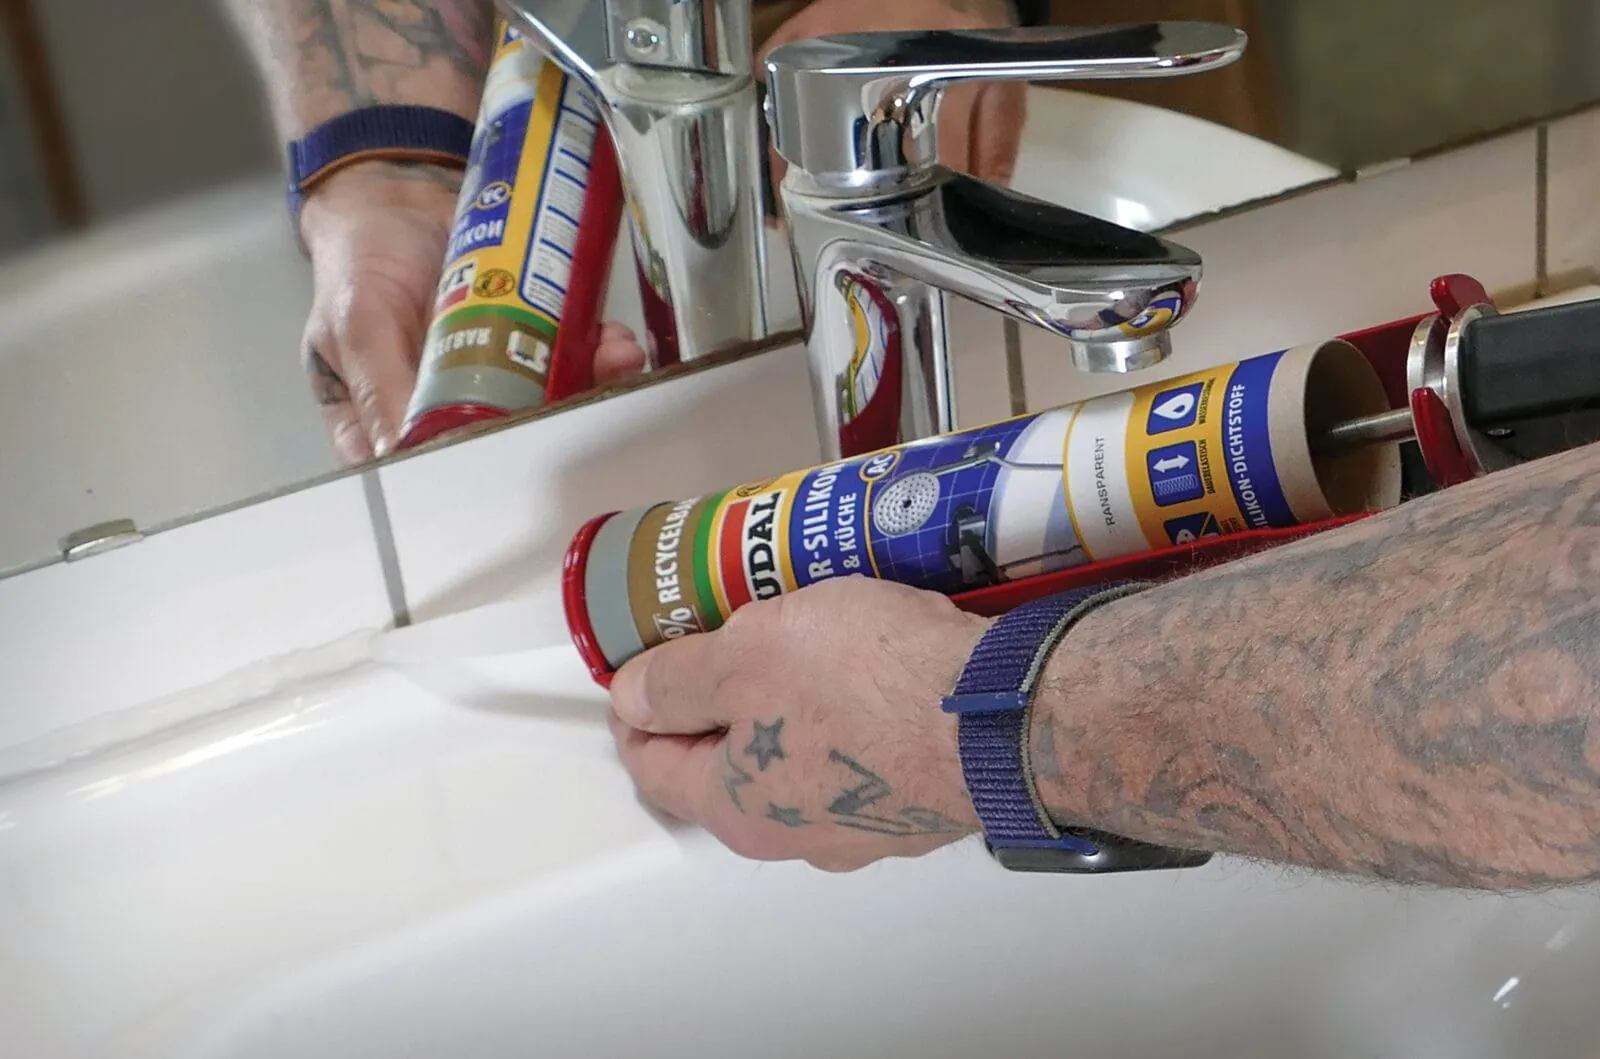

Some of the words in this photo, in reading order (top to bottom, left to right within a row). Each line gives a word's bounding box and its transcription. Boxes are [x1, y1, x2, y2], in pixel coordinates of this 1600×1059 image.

[866, 454, 894, 475] AC
[1094, 435, 1117, 528] RANSPARENT
[1227, 383, 1268, 528] ILIKON-DICHTSTOFF
[655, 495, 702, 604] RECYCELBA
[748, 491, 782, 601] UDAL
[803, 463, 845, 580] R-SILIKON
[834, 492, 857, 552] KÜCHE
[843, 554, 860, 569] &
